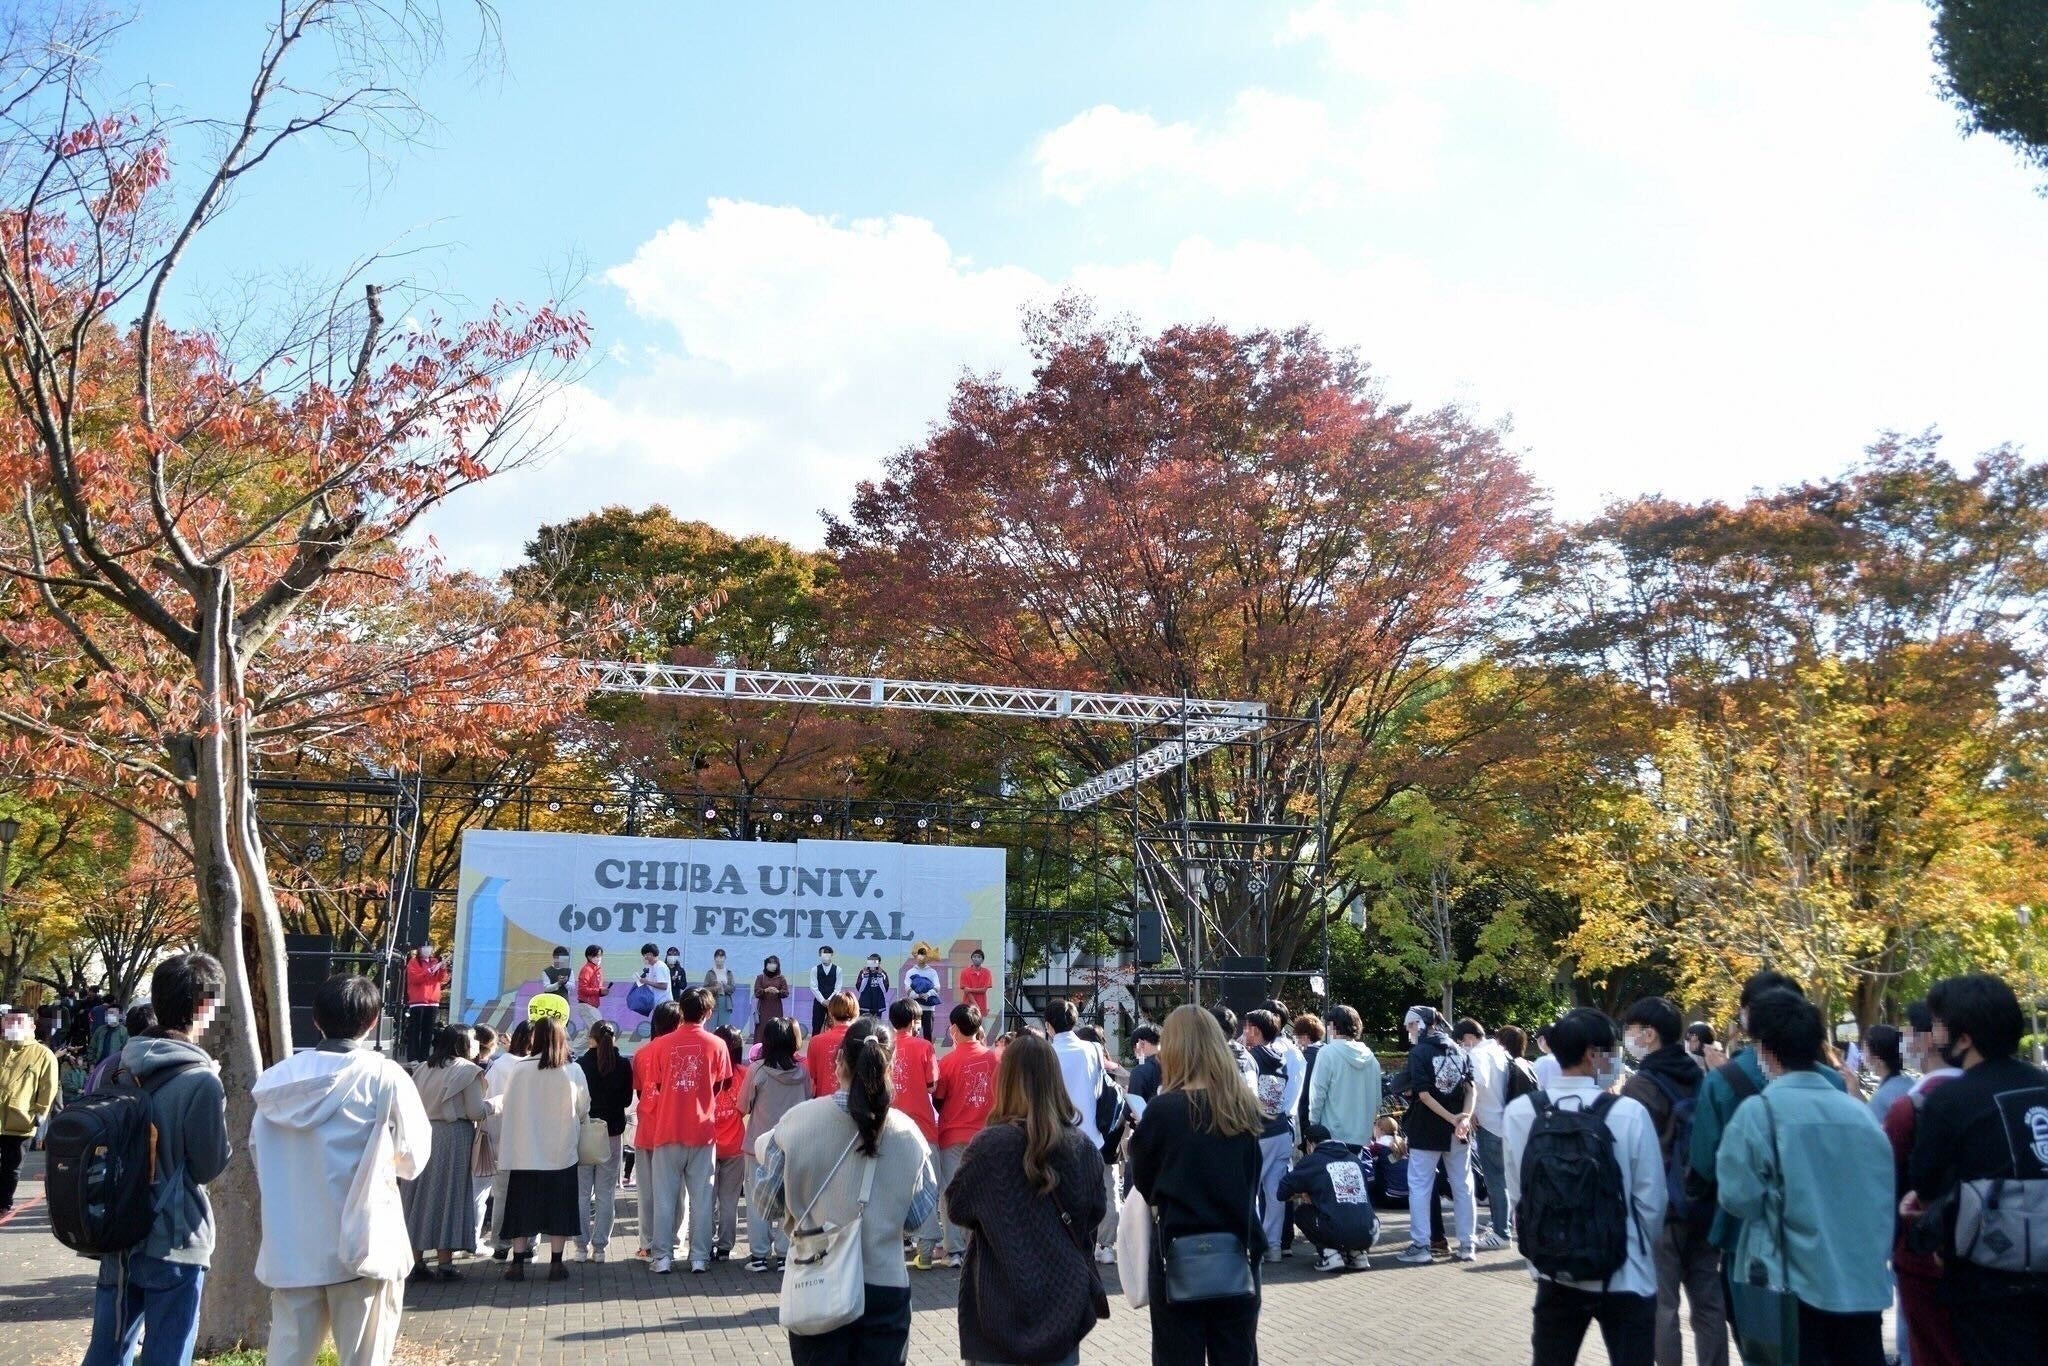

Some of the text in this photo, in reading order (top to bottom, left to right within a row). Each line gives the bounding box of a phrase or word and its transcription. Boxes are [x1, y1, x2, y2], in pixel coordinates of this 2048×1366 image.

[595, 858, 884, 899] CHIBA UNIV.
[558, 902, 915, 942] 60TH FESTIVAL
